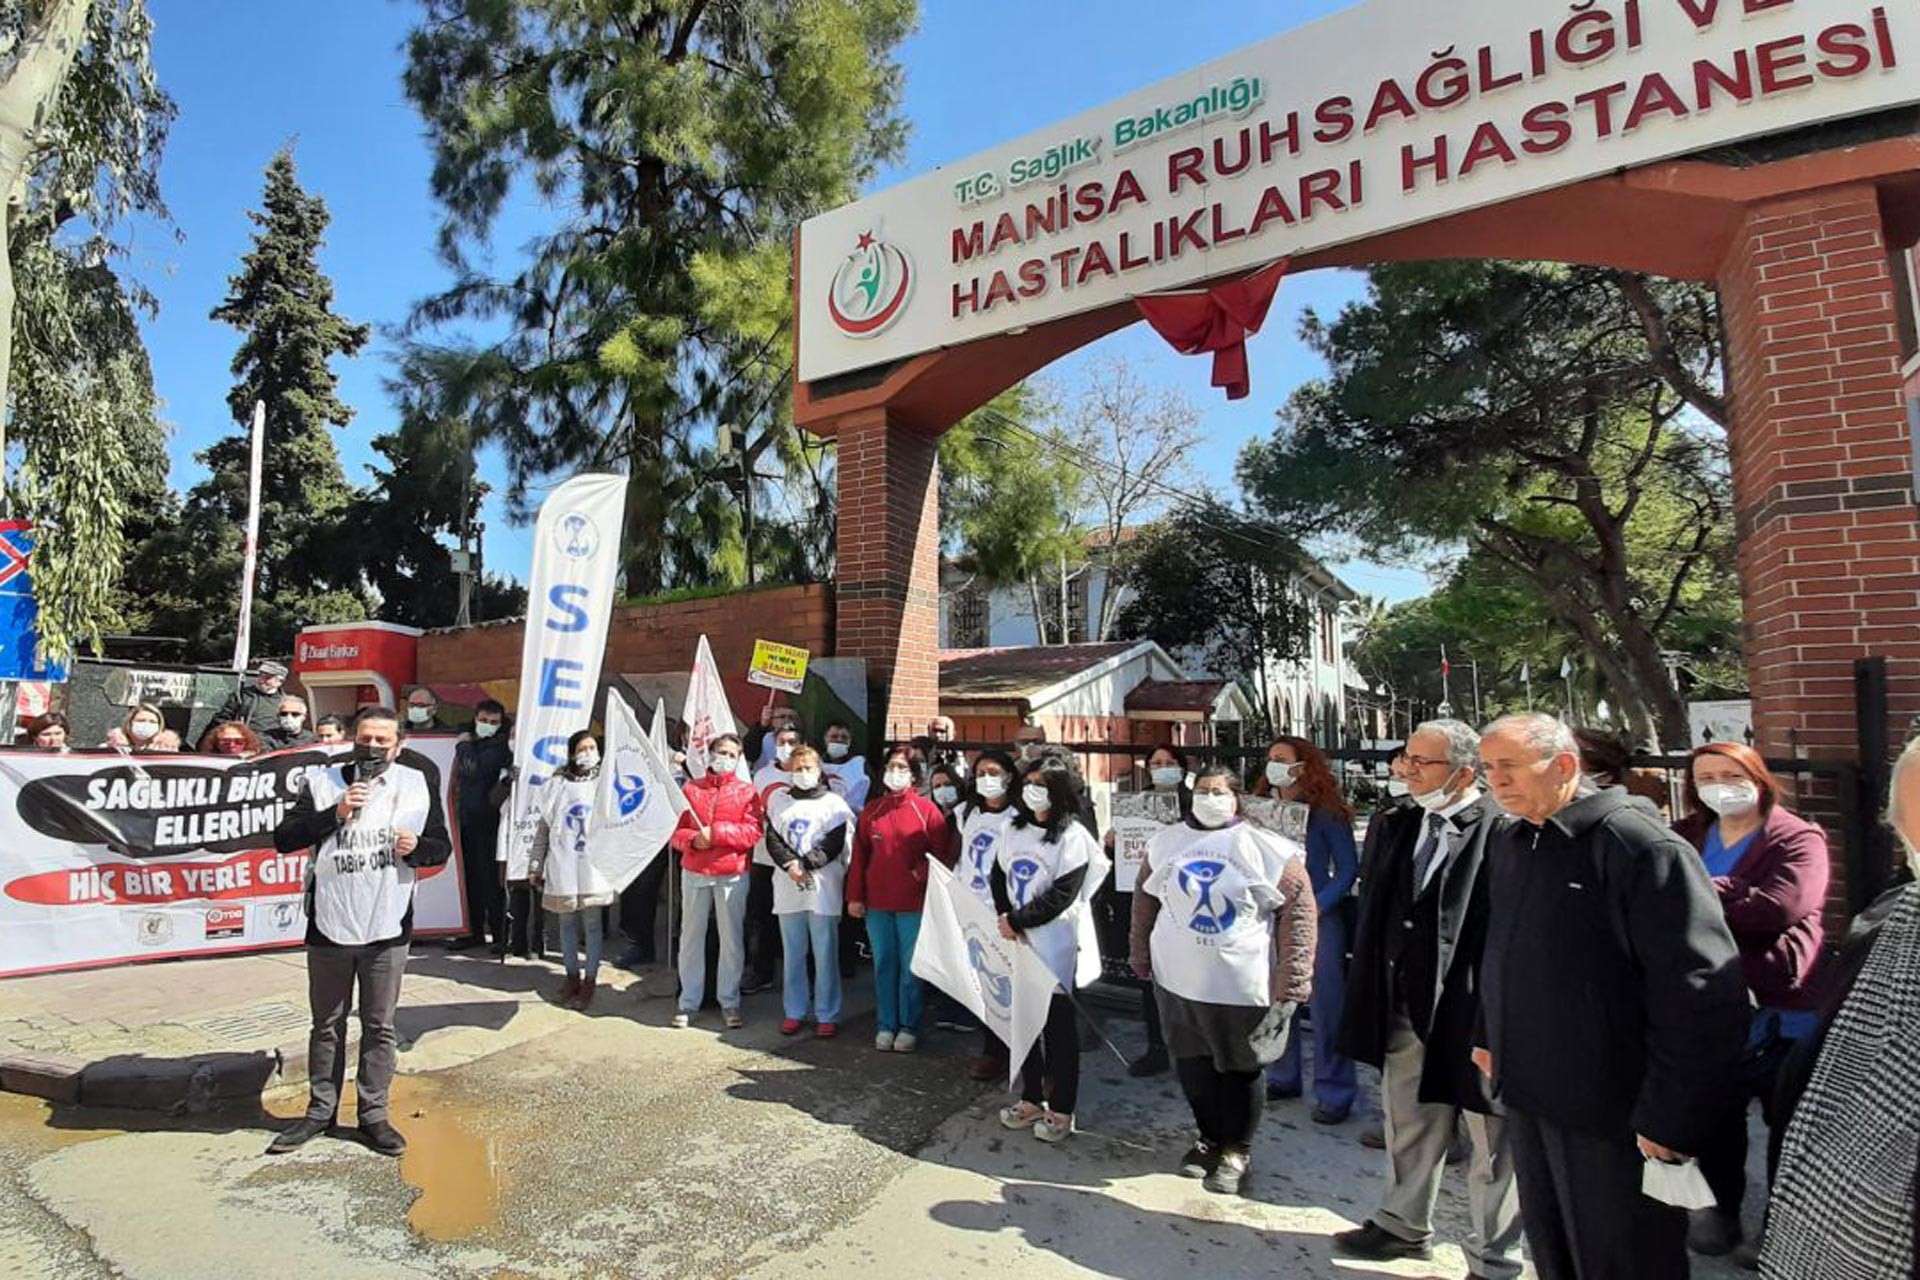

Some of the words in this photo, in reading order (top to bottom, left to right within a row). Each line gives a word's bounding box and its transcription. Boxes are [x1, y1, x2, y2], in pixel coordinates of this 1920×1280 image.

[952, 159, 1365, 317] HASTALIKLARI
[1401, 7, 1896, 191] HASTANESİ
[957, 172, 998, 202] T.C.
[1010, 134, 1092, 184] Sağlık
[1113, 75, 1264, 147] Bakanlığı
[952, 171, 1147, 263] MANİSA
[227, 770, 276, 802] BİR
[69, 865, 116, 902] HİÇ
[124, 865, 173, 896] BİR
[181, 860, 252, 893] YERE
